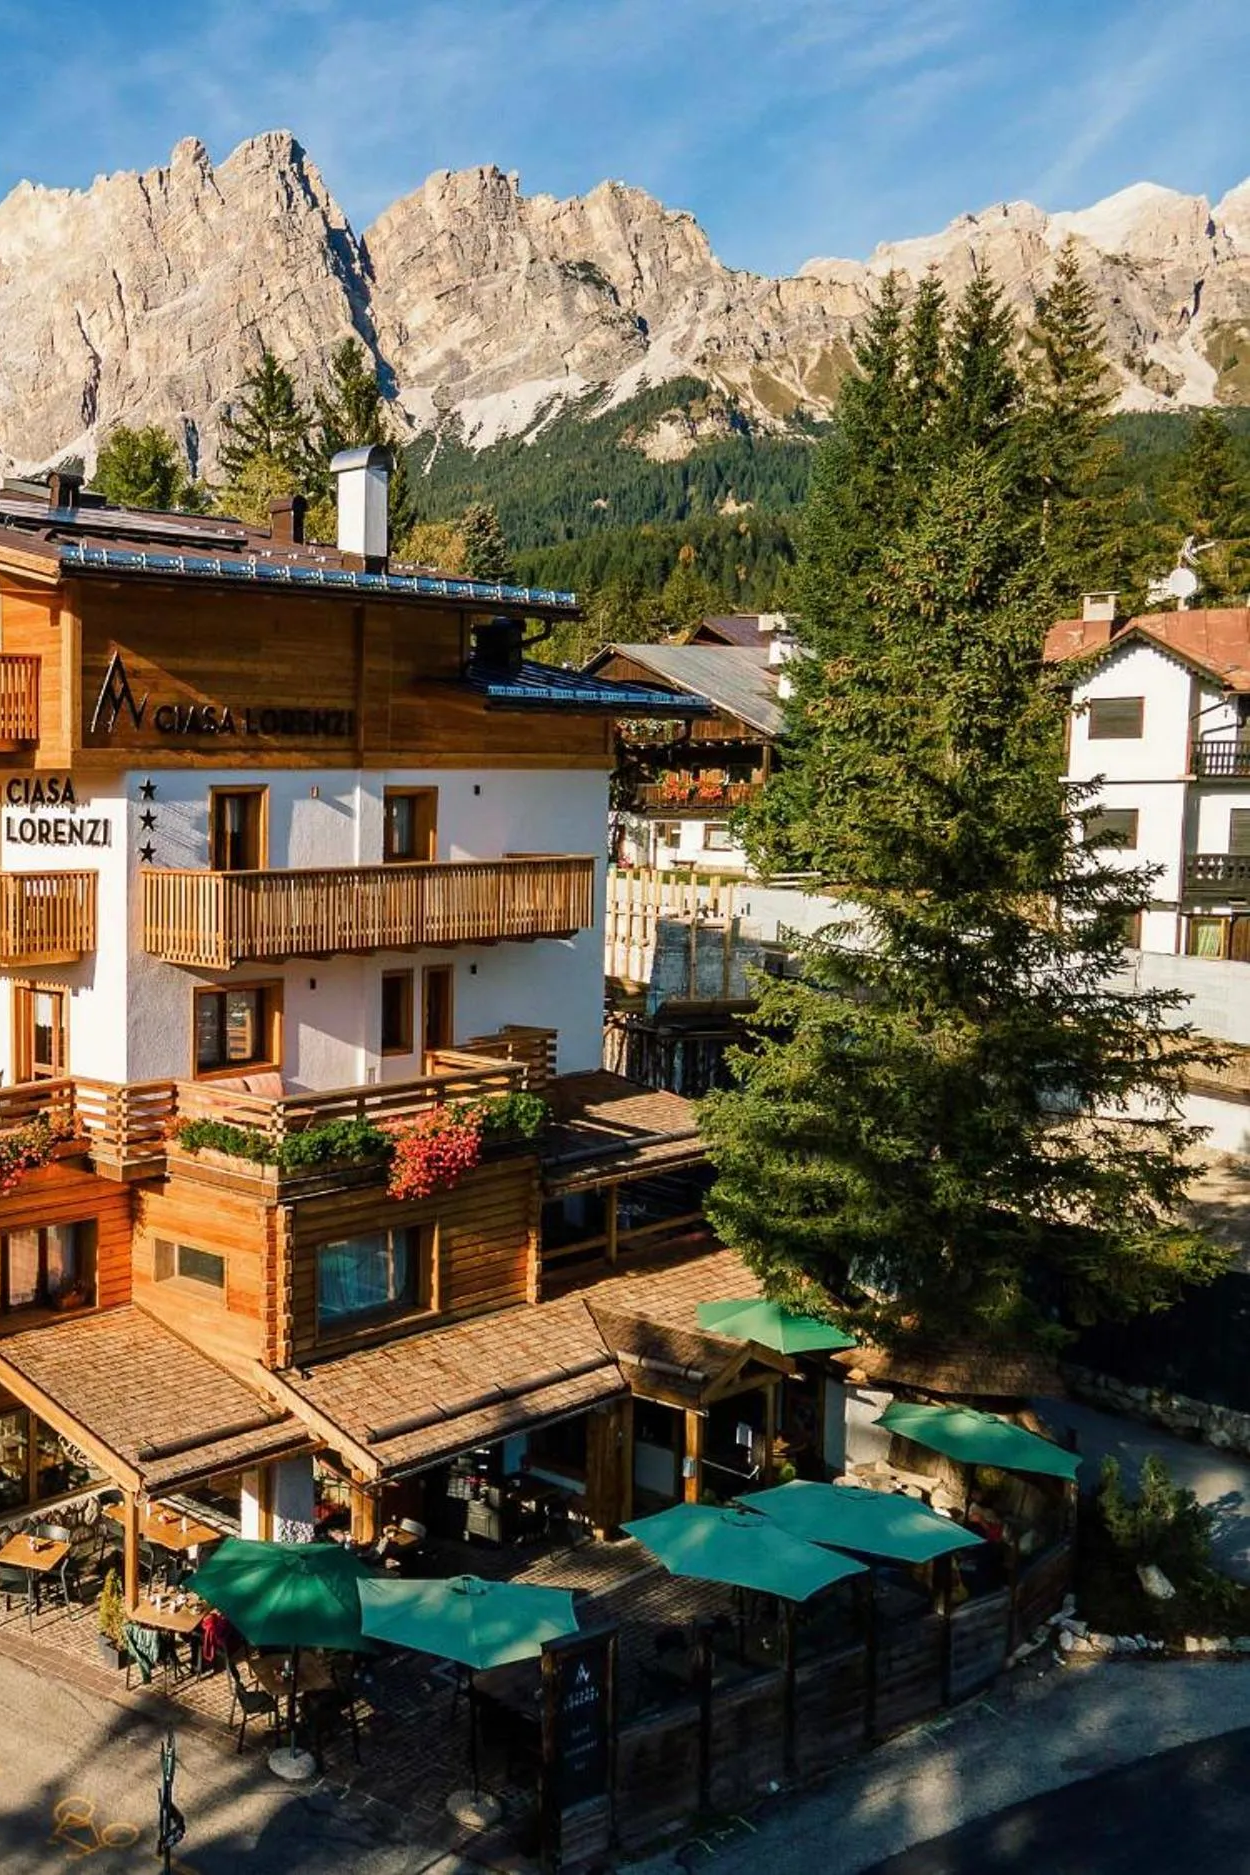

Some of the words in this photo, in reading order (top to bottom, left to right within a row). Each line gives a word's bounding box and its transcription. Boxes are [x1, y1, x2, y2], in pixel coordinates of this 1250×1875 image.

[154, 705, 237, 735] CIASA
[6, 777, 76, 804] CIASA
[6, 817, 110, 847] LORENZI
